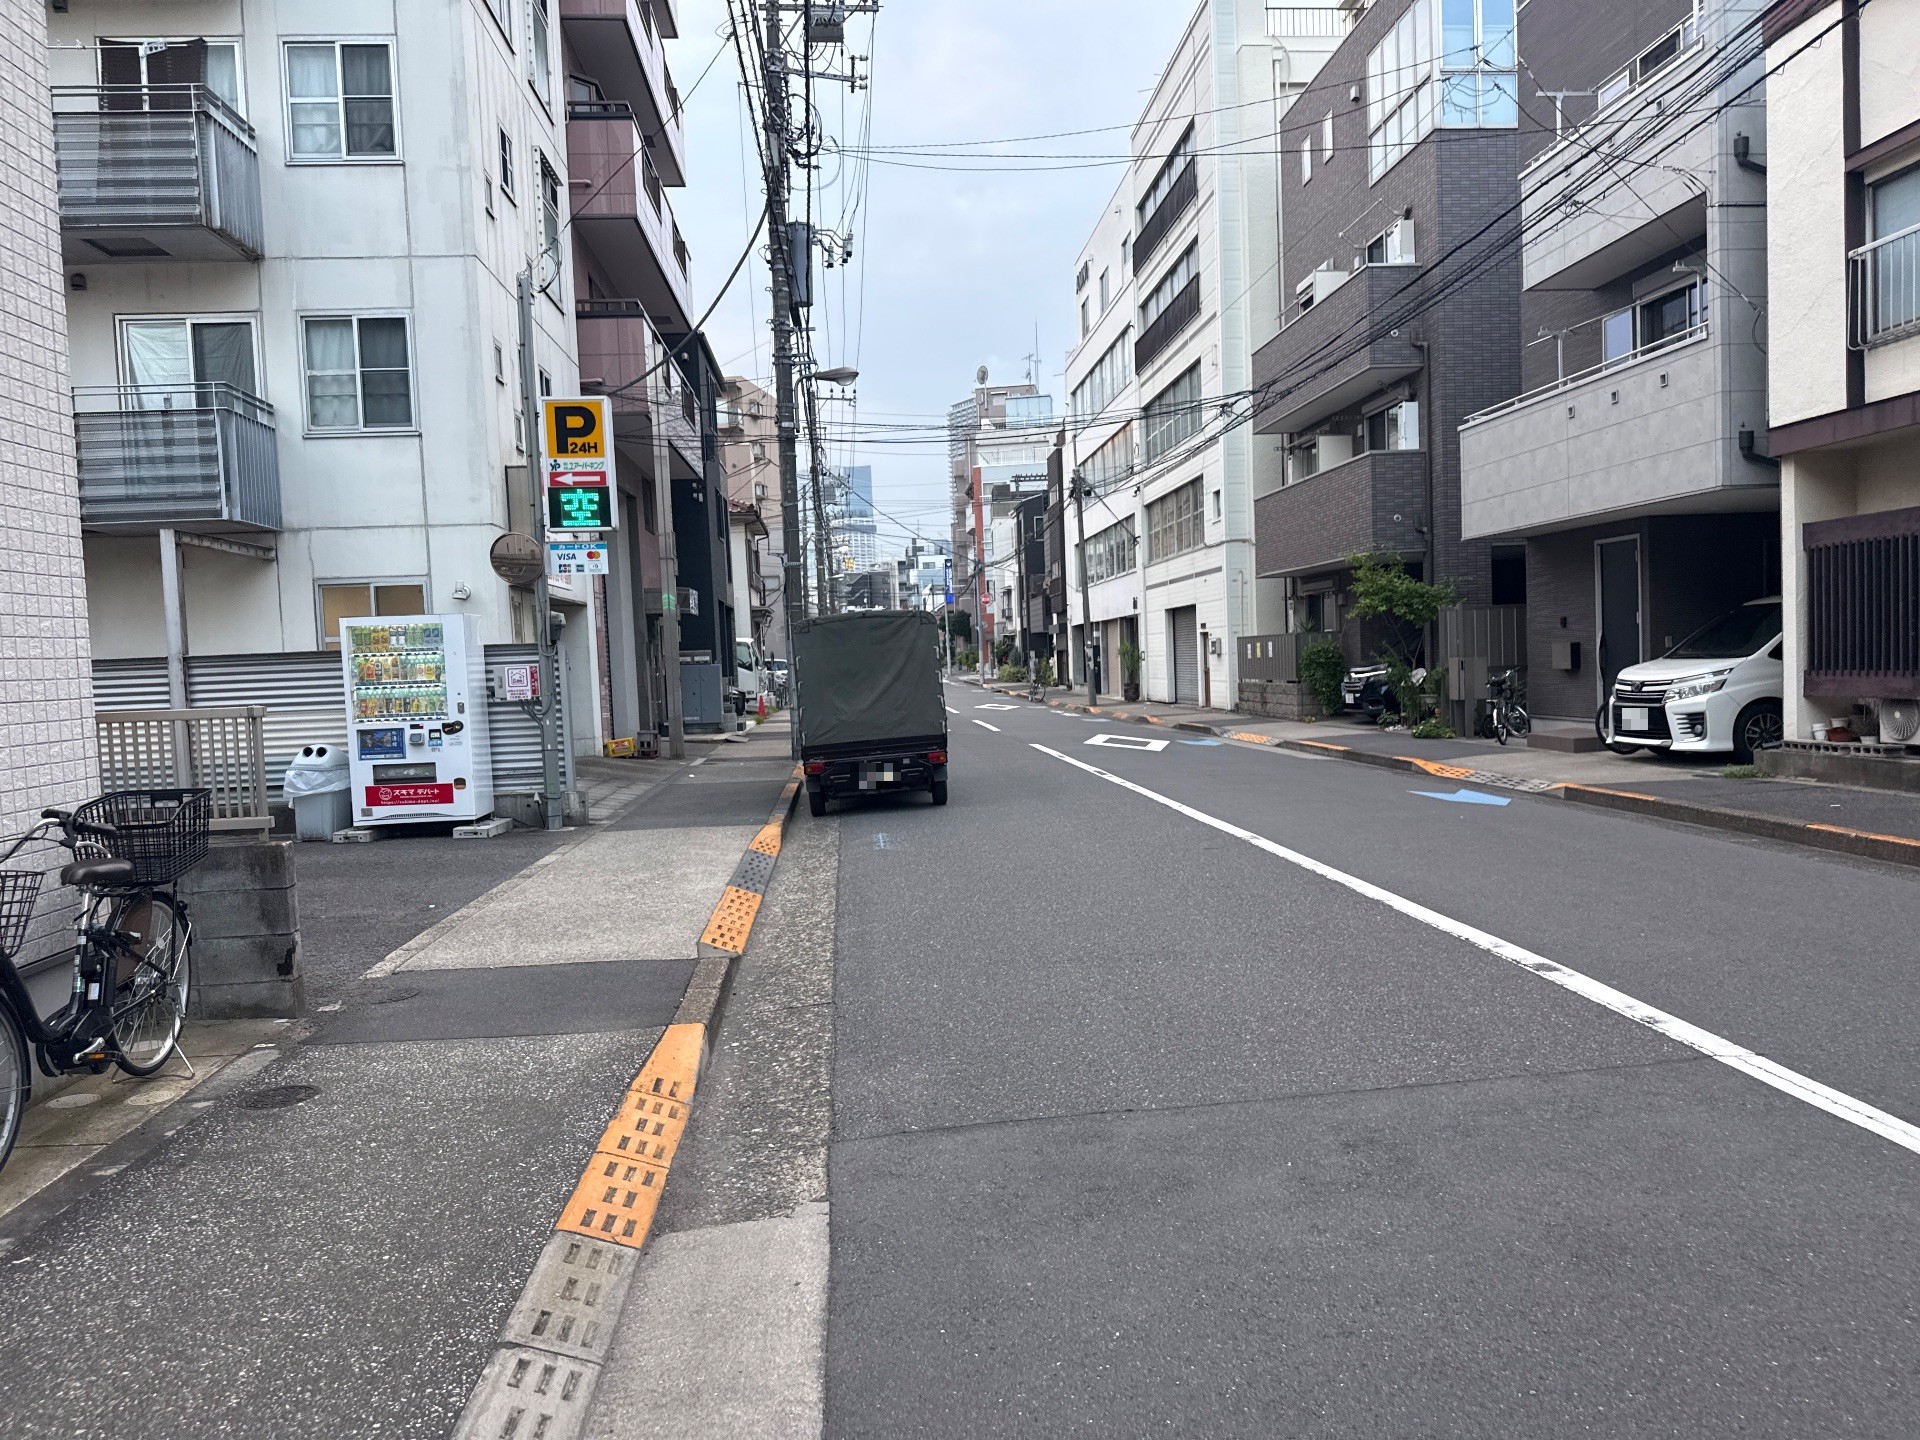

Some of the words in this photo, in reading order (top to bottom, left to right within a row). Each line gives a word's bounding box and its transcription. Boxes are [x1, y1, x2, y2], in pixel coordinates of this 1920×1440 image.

[554, 406, 596, 454] P
[570, 441, 598, 454] 24H
[561, 488, 601, 526] 空
[557, 552, 577, 561] VISA
